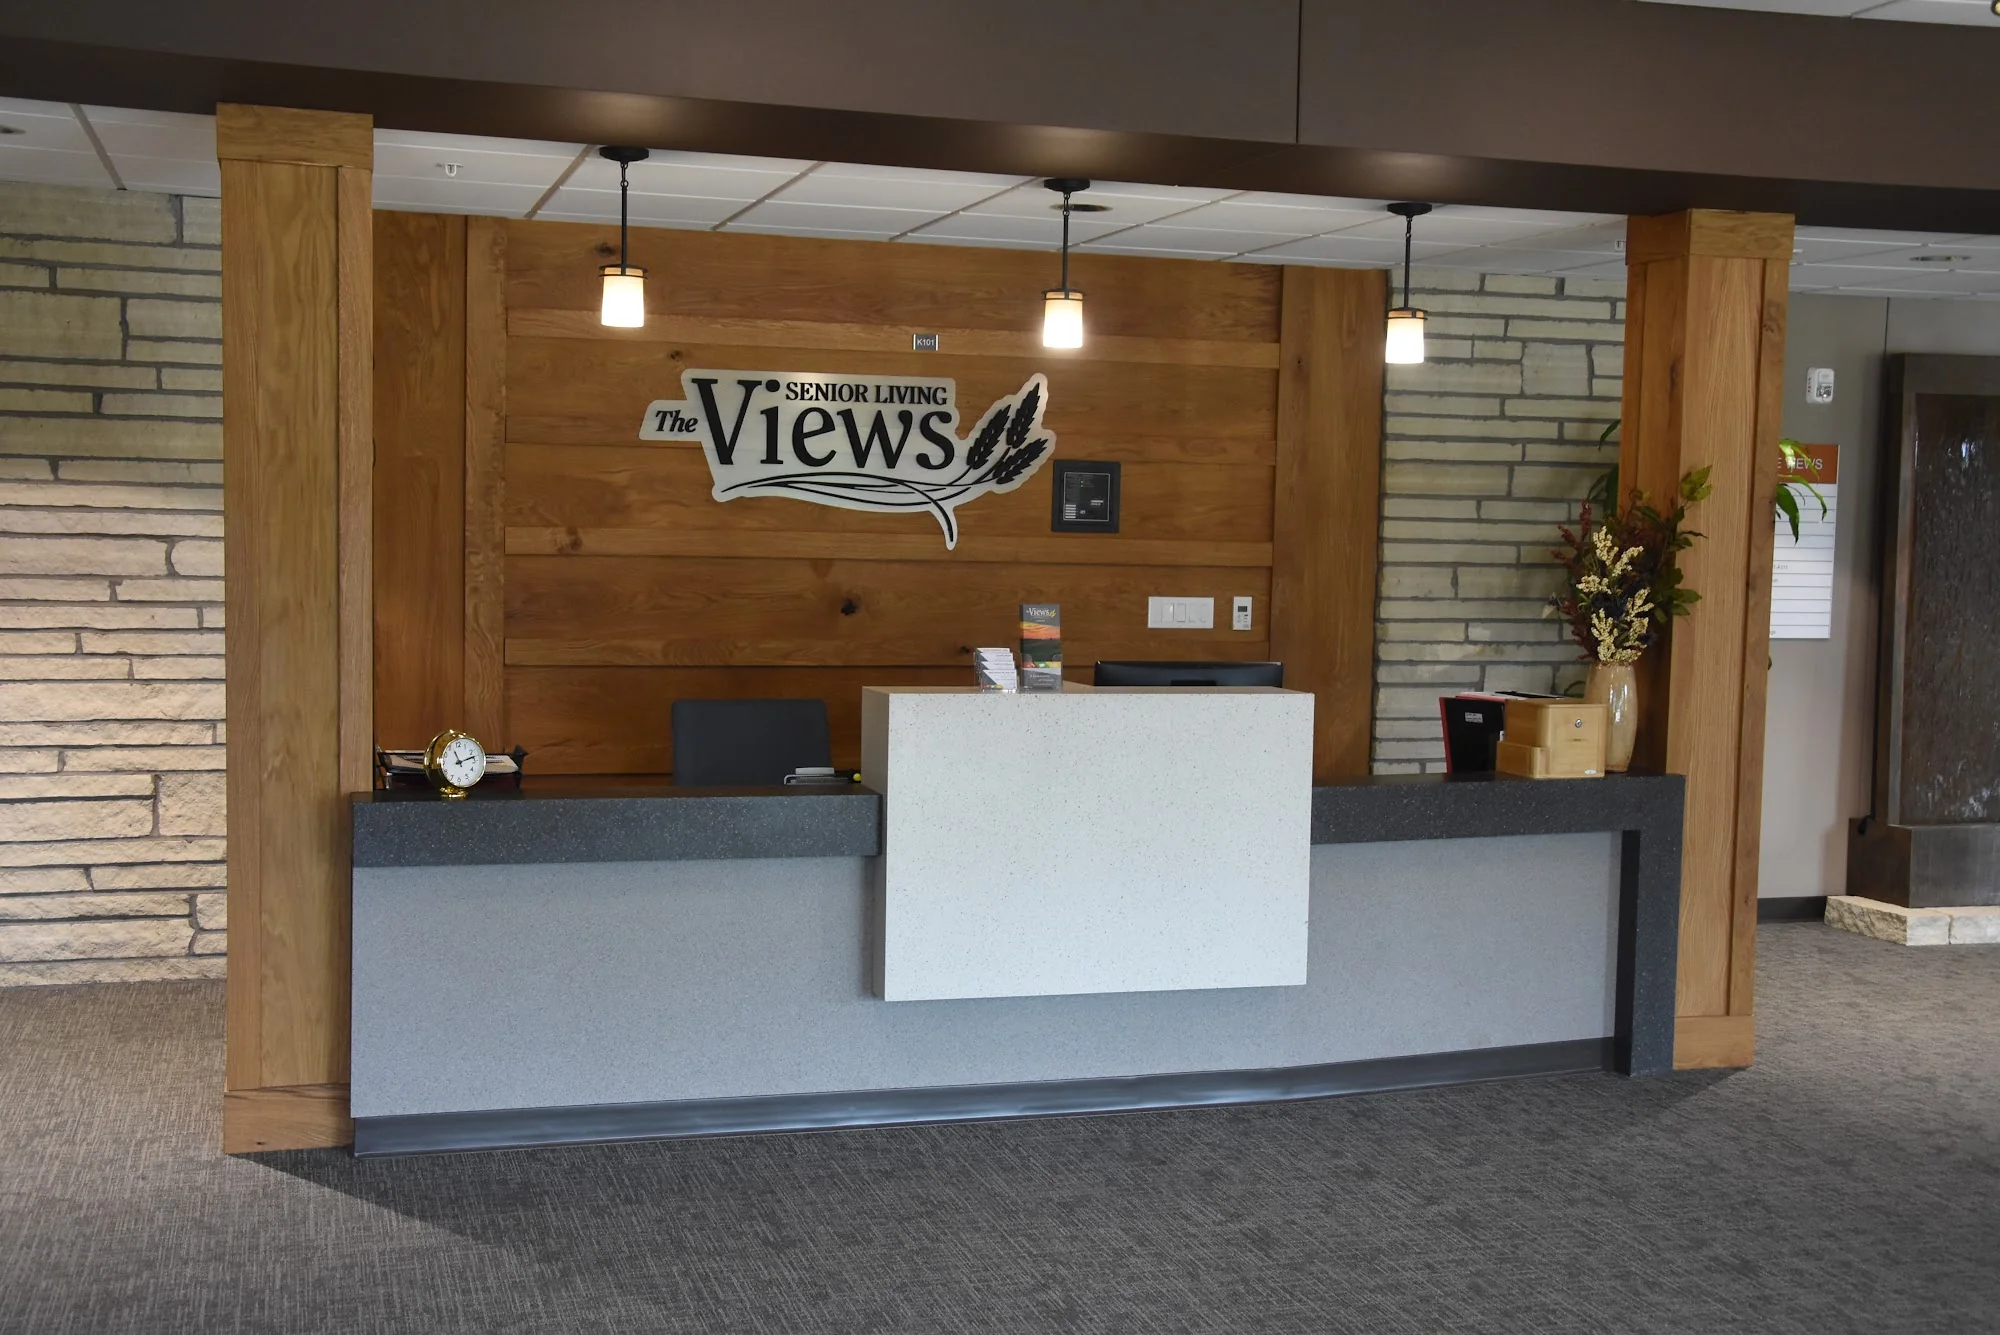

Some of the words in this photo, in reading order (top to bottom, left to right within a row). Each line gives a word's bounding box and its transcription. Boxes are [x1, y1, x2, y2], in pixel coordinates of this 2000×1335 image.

[917, 338, 935, 346] K101
[785, 382, 868, 403] SENIOR
[874, 384, 948, 405] LIVING
[655, 410, 698, 433] The
[691, 378, 956, 470] Views
